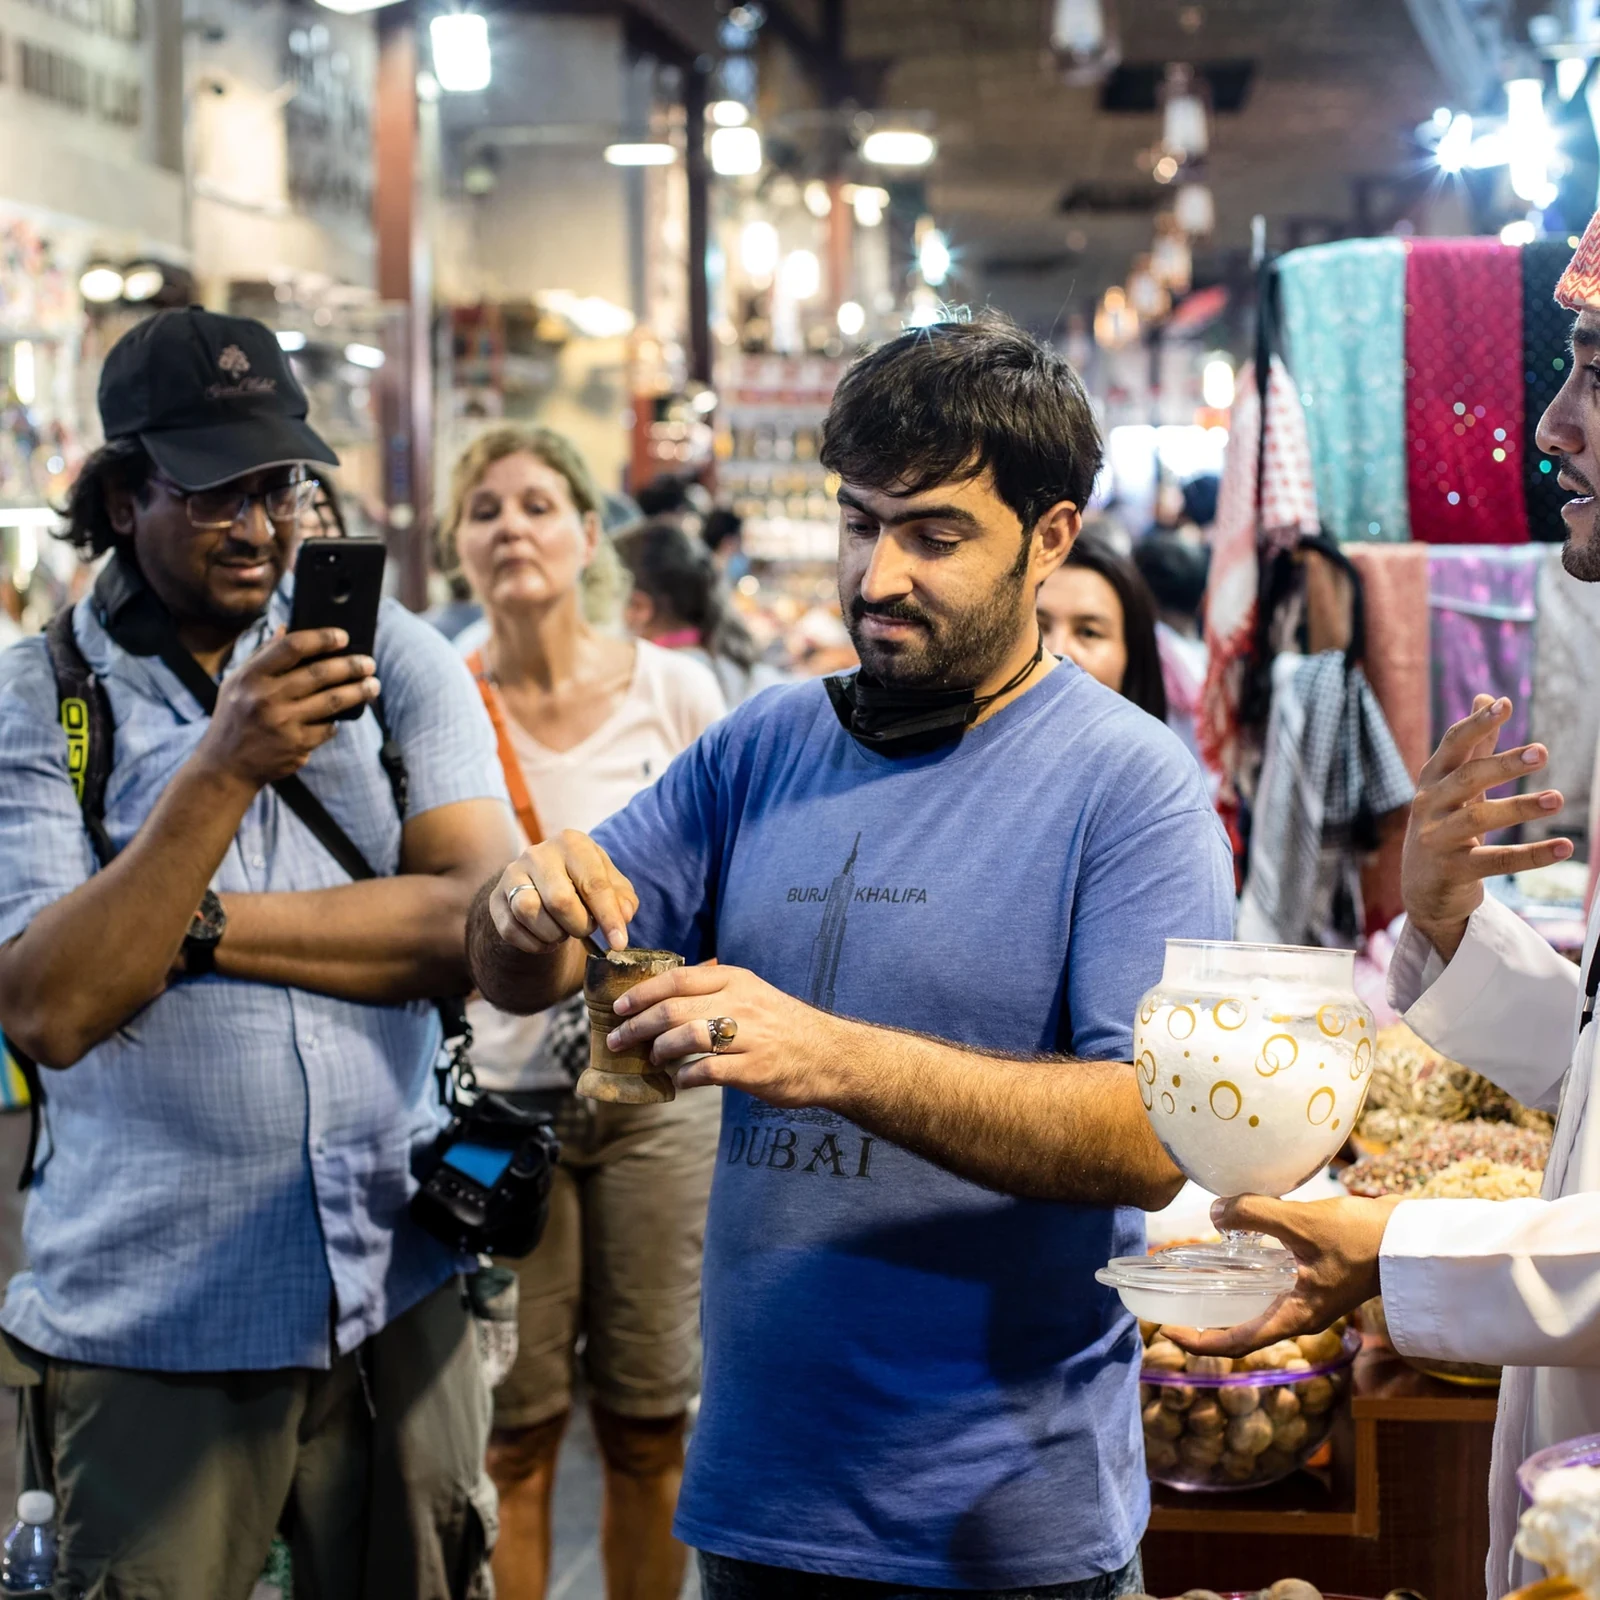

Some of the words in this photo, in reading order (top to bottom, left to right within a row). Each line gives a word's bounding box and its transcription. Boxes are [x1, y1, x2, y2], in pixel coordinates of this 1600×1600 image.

[786, 887, 829, 903] BURJ
[854, 887, 927, 904] KHALIFA
[727, 1126, 874, 1181] DUBAI
